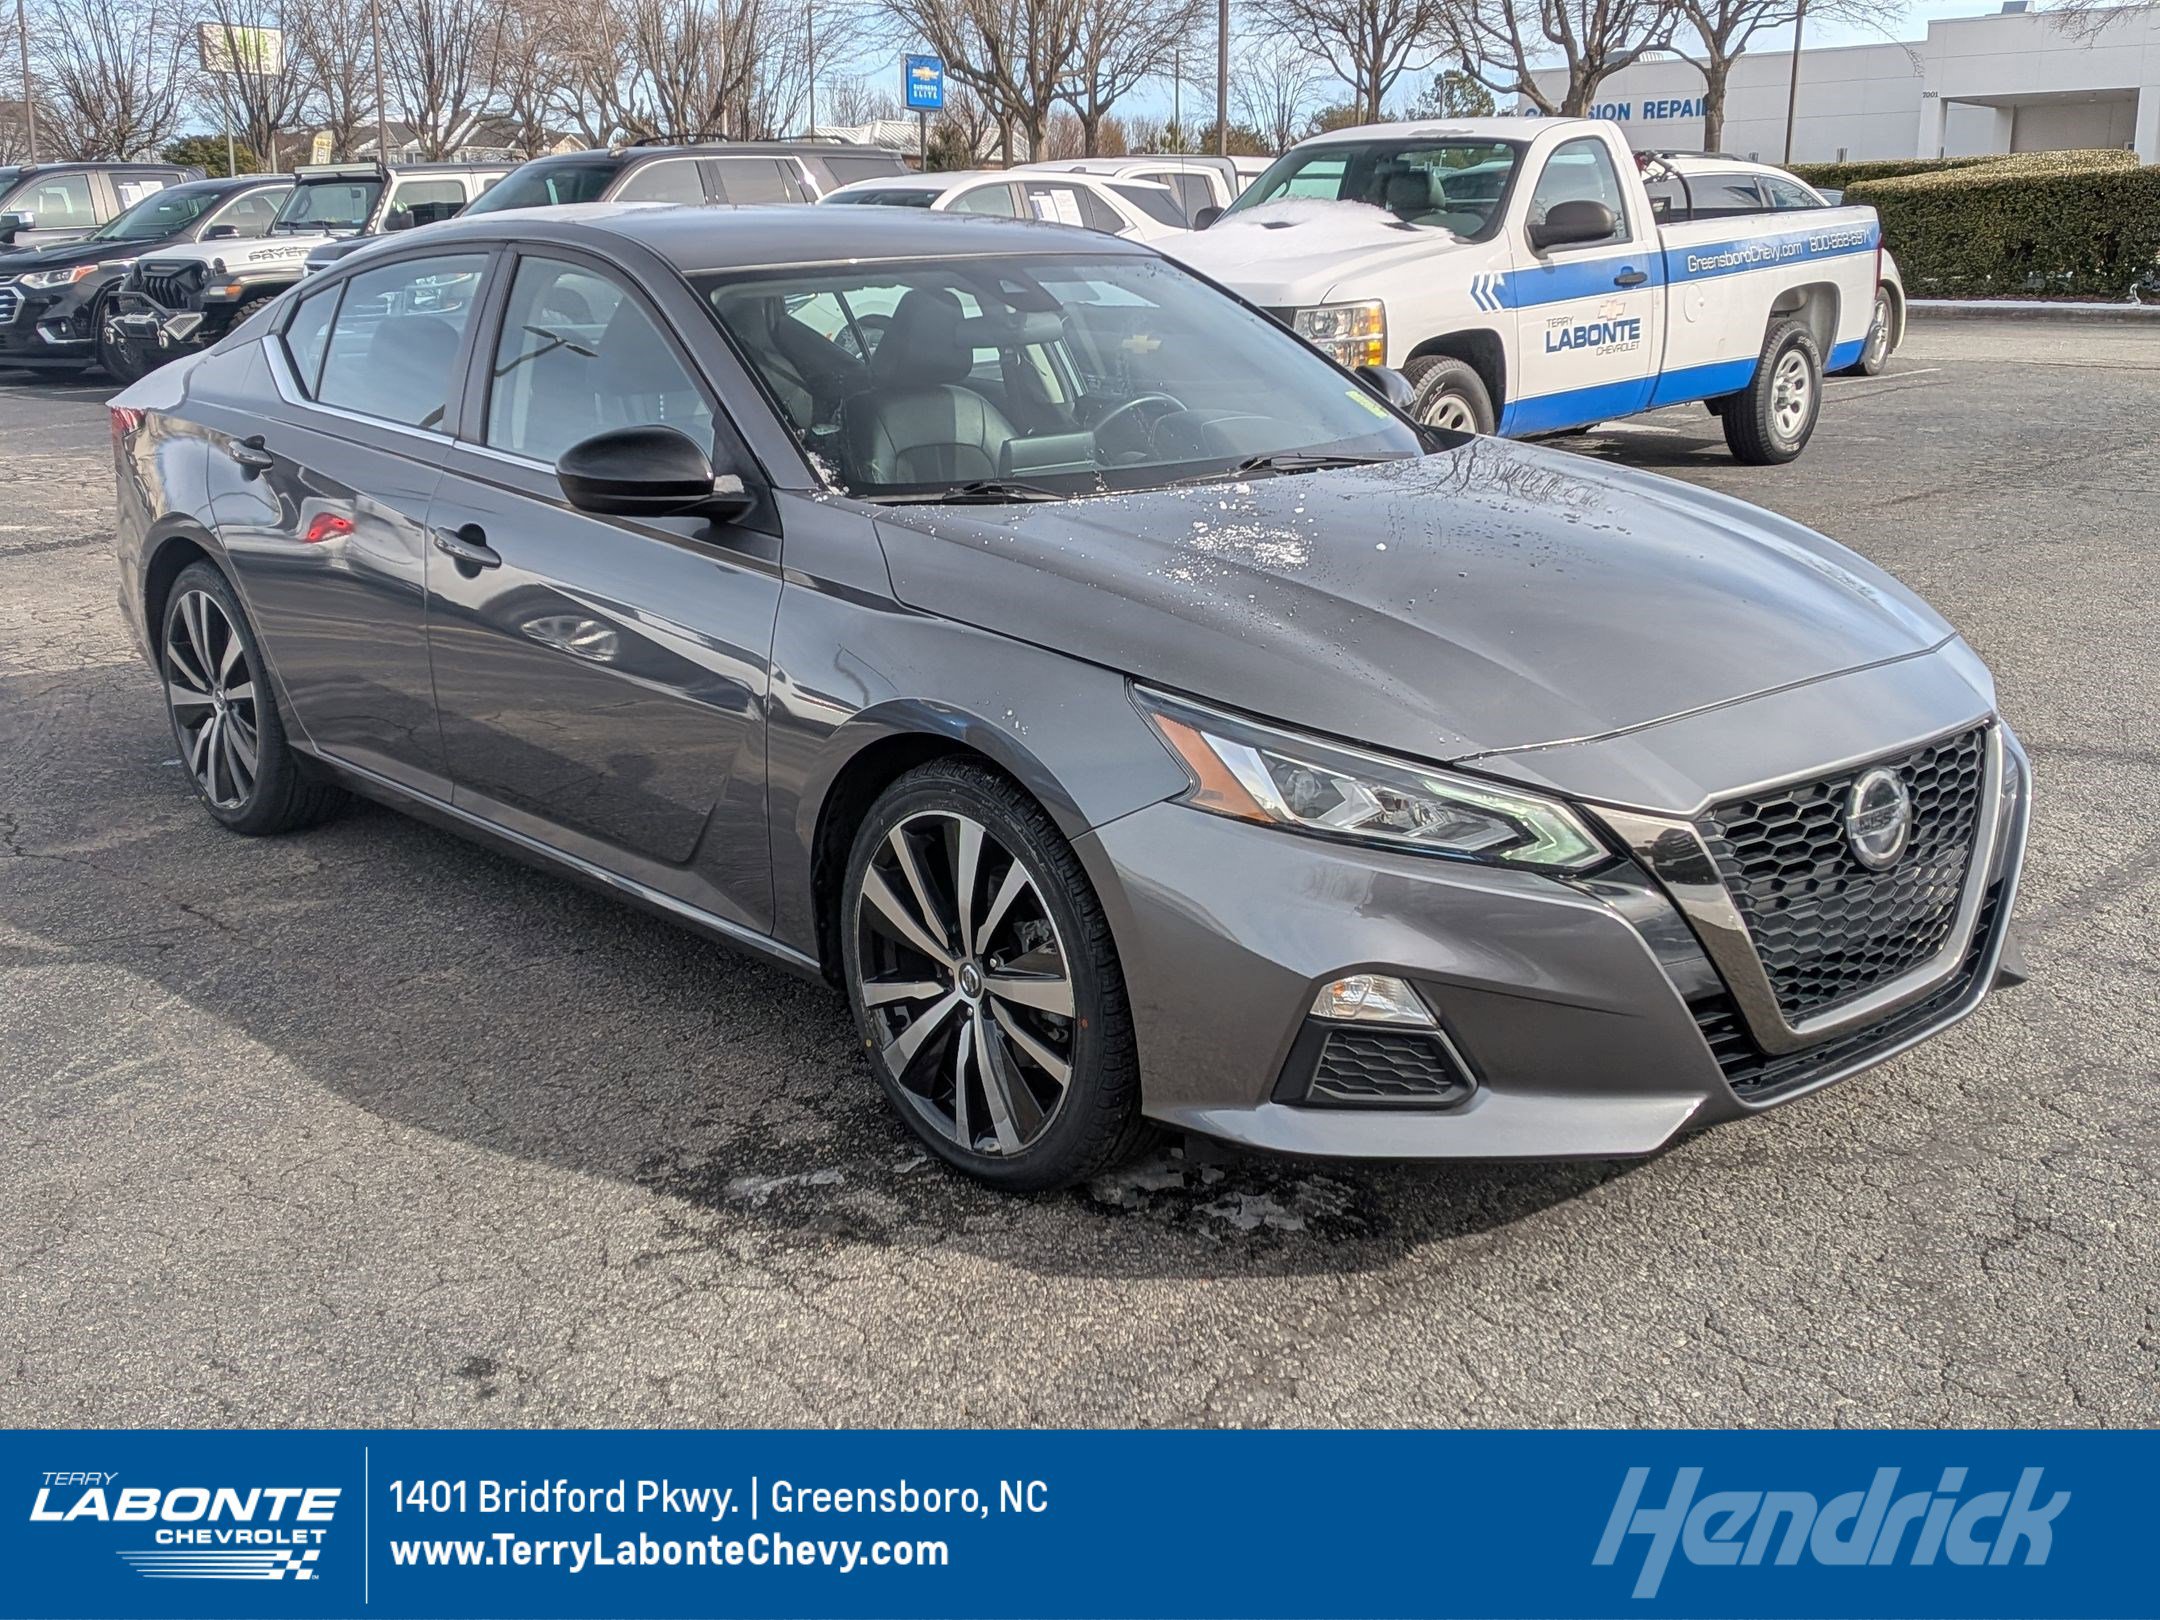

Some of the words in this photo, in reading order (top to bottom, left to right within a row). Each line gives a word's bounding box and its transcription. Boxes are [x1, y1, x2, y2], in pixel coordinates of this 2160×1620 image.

[913, 90, 938, 99] ELITE
[1546, 316, 1574, 328] TERRY
[1546, 318, 1641, 353] LABONTE
[1596, 340, 1641, 356] CHEVROLET
